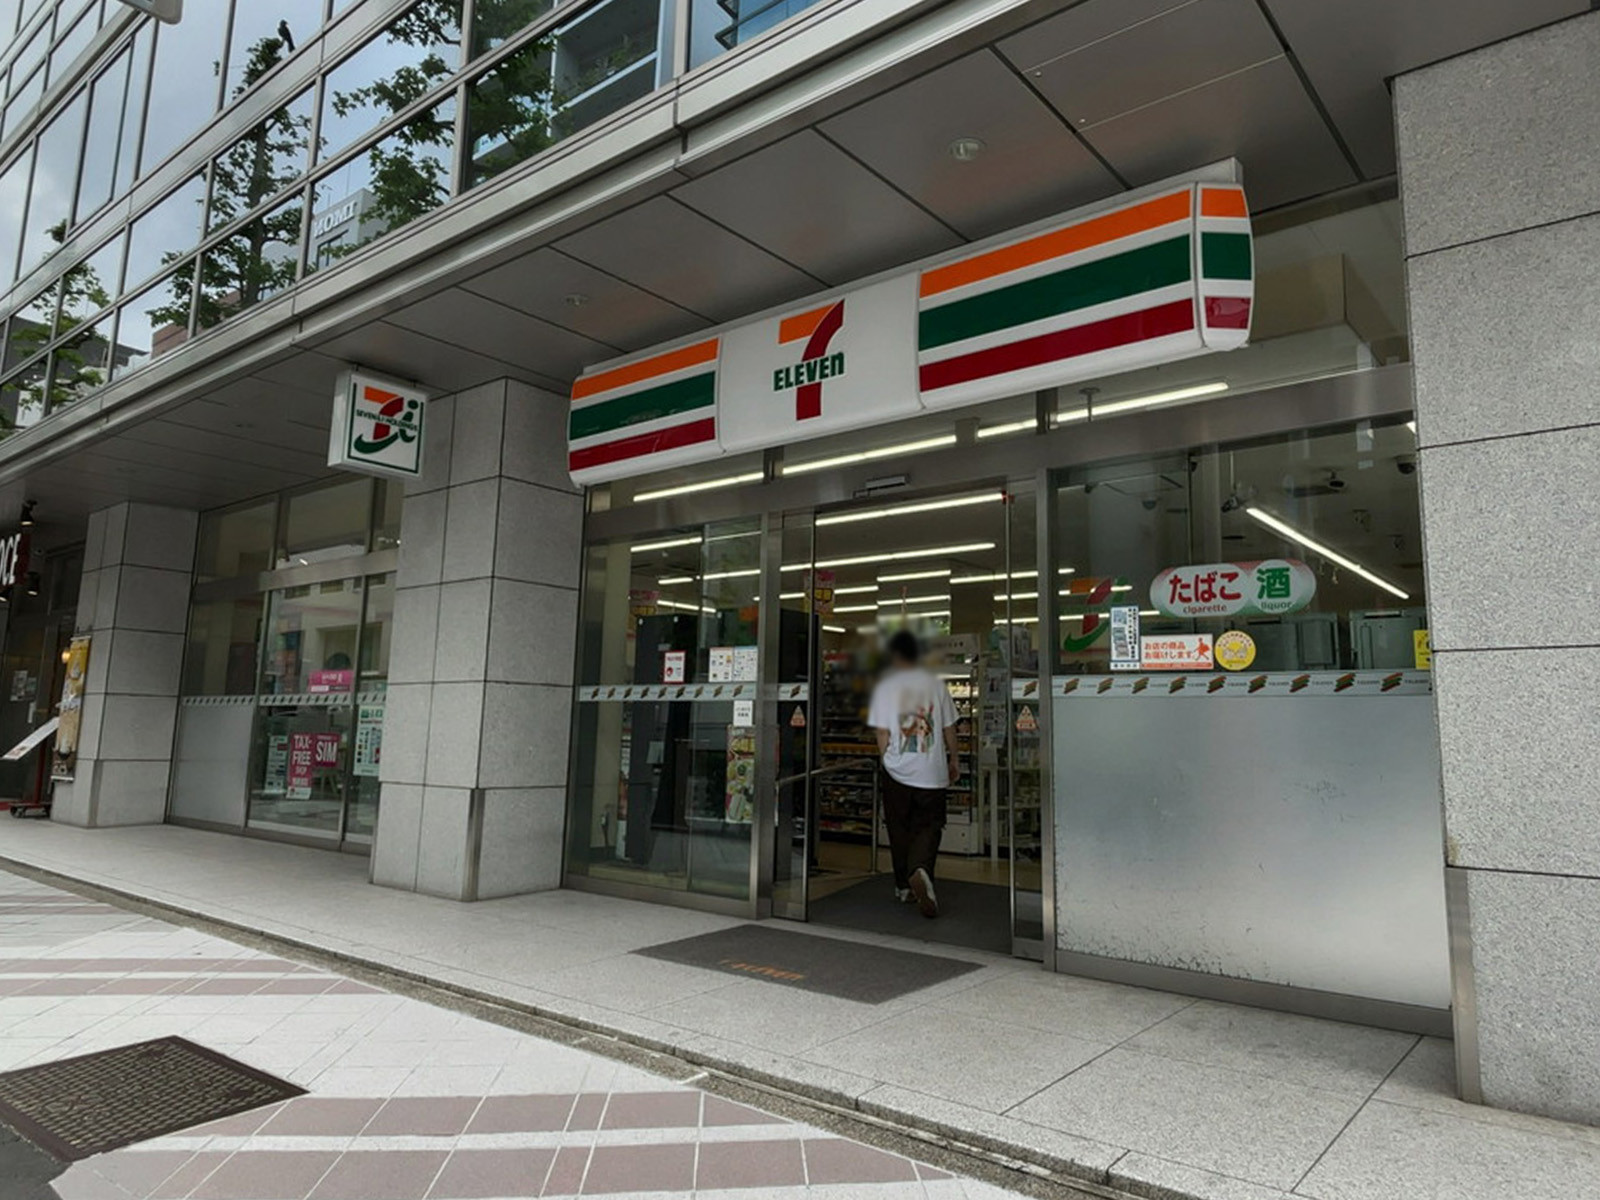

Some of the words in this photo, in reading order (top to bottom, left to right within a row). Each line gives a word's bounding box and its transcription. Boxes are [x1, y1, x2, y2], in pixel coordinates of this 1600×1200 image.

[778, 298, 845, 421] 7
[1169, 571, 1242, 604] たばこ
[1256, 567, 1291, 599] 酒
[1183, 604, 1227, 615] cigarette
[1261, 601, 1293, 611] liquor
[292, 750, 312, 766] FREE
[315, 741, 338, 762] SIM
